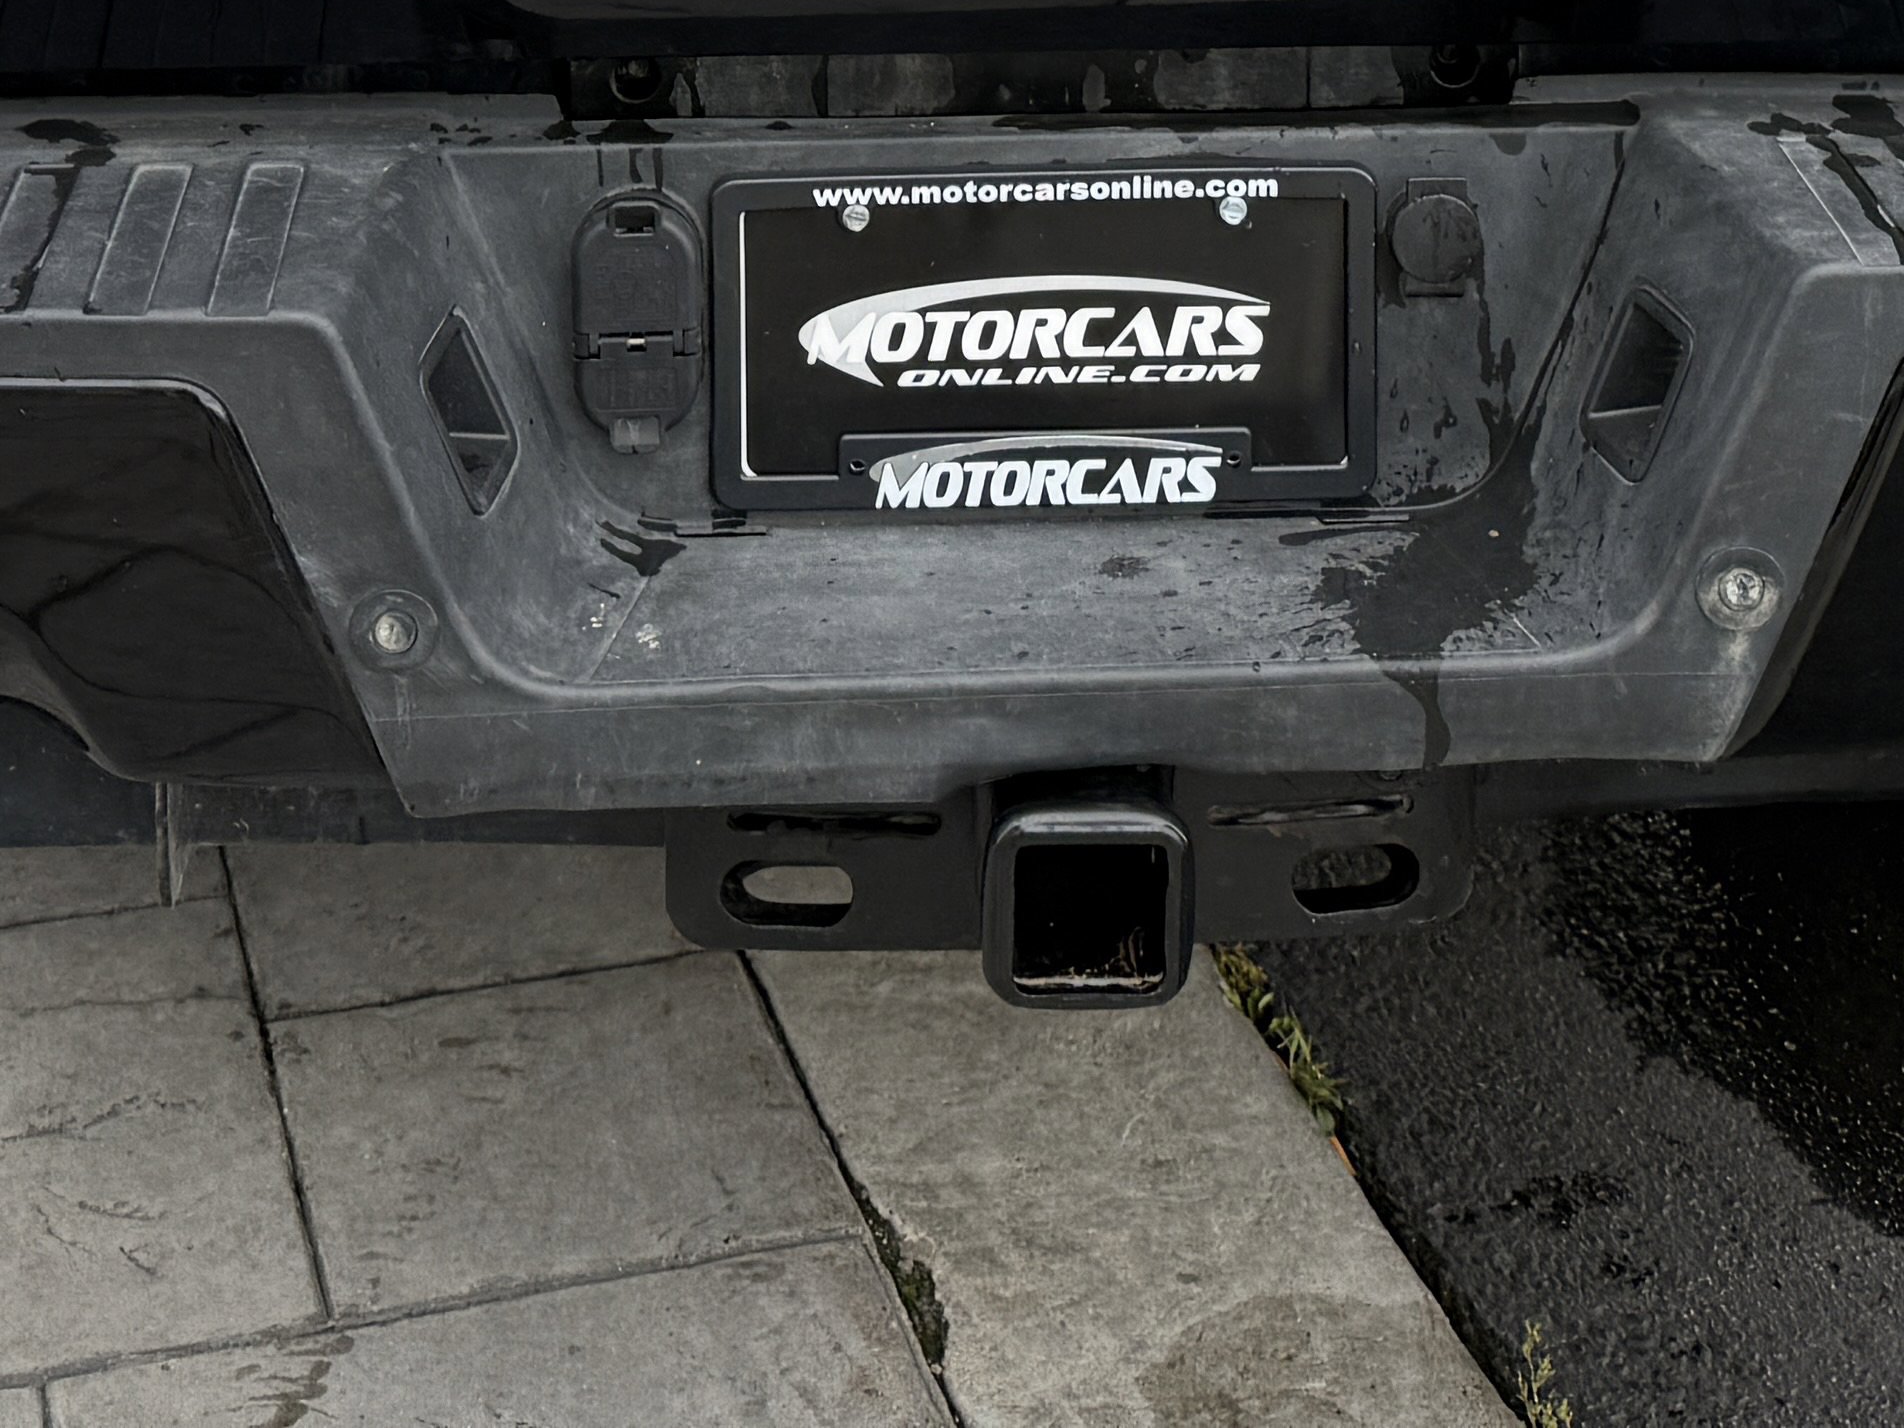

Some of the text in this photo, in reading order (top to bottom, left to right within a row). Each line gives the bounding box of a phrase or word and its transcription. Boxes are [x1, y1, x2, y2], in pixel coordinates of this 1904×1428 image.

[812, 174, 1280, 207] www.motorcarsonline.com
[807, 304, 1271, 365] MOTORCARS
[897, 363, 1262, 388] ONLINE.COM
[874, 455, 1224, 510] MOTORCARS
